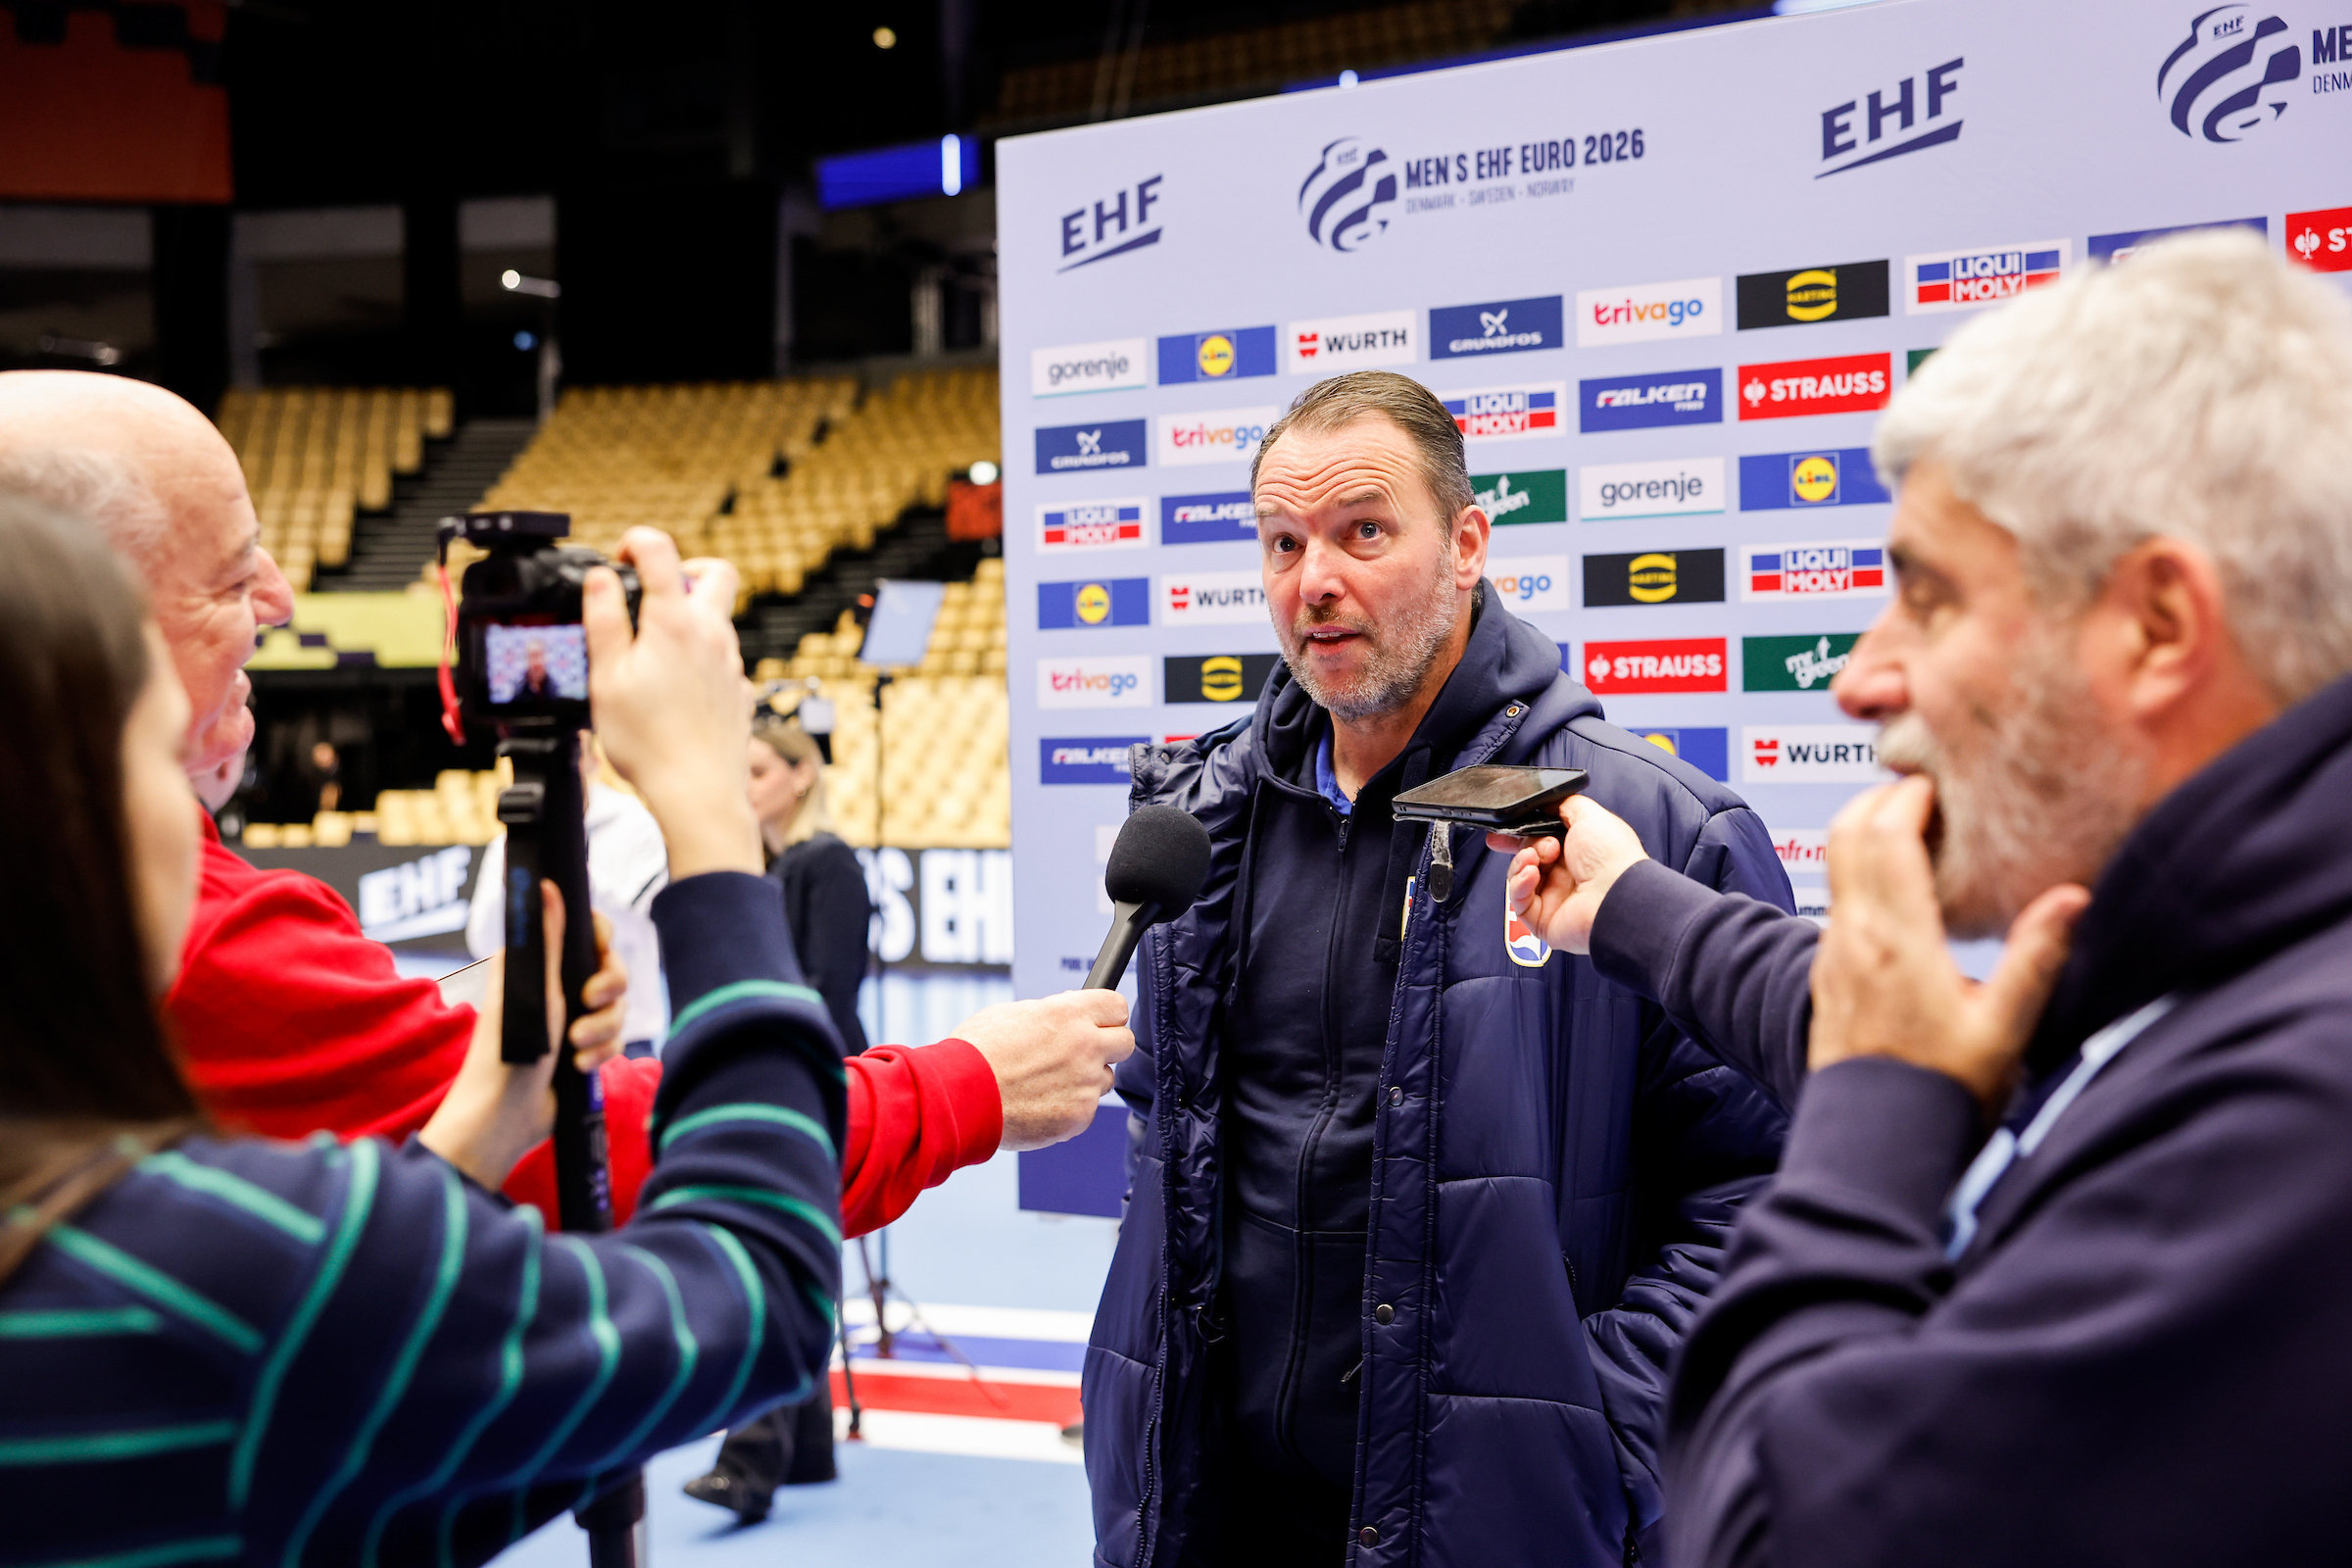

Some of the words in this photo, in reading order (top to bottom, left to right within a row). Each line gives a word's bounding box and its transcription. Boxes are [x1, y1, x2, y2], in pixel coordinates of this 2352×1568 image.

[2314, 73, 2352, 95] DENM
[1822, 57, 1964, 161] EHF
[1477, 146, 1513, 179] EHF
[1521, 138, 1576, 173] EURO
[1585, 128, 1644, 165] 2026
[1062, 173, 1163, 258] EHF
[1955, 253, 2021, 279] LIQUI
[1955, 274, 2022, 301] MOLY
[1594, 299, 1703, 326] trivago
[1326, 328, 1408, 354] WÜRTH
[1448, 331, 1544, 353] GRUNDFOS
[1049, 351, 1129, 384] gorenje
[1596, 382, 1707, 408] FALKEN
[1770, 371, 1886, 402] STRAUSS
[1472, 393, 1526, 415] LIQUI
[1472, 412, 1527, 434] MOLY
[1173, 423, 1264, 450] trivago
[1051, 450, 1130, 469] GRUNDFOS
[1601, 471, 1702, 507] gorenje
[1787, 549, 1847, 571] LIQUI
[1787, 569, 1848, 592] MOLY
[1614, 654, 1722, 679] STRAUSS
[1052, 668, 1138, 696] trivago
